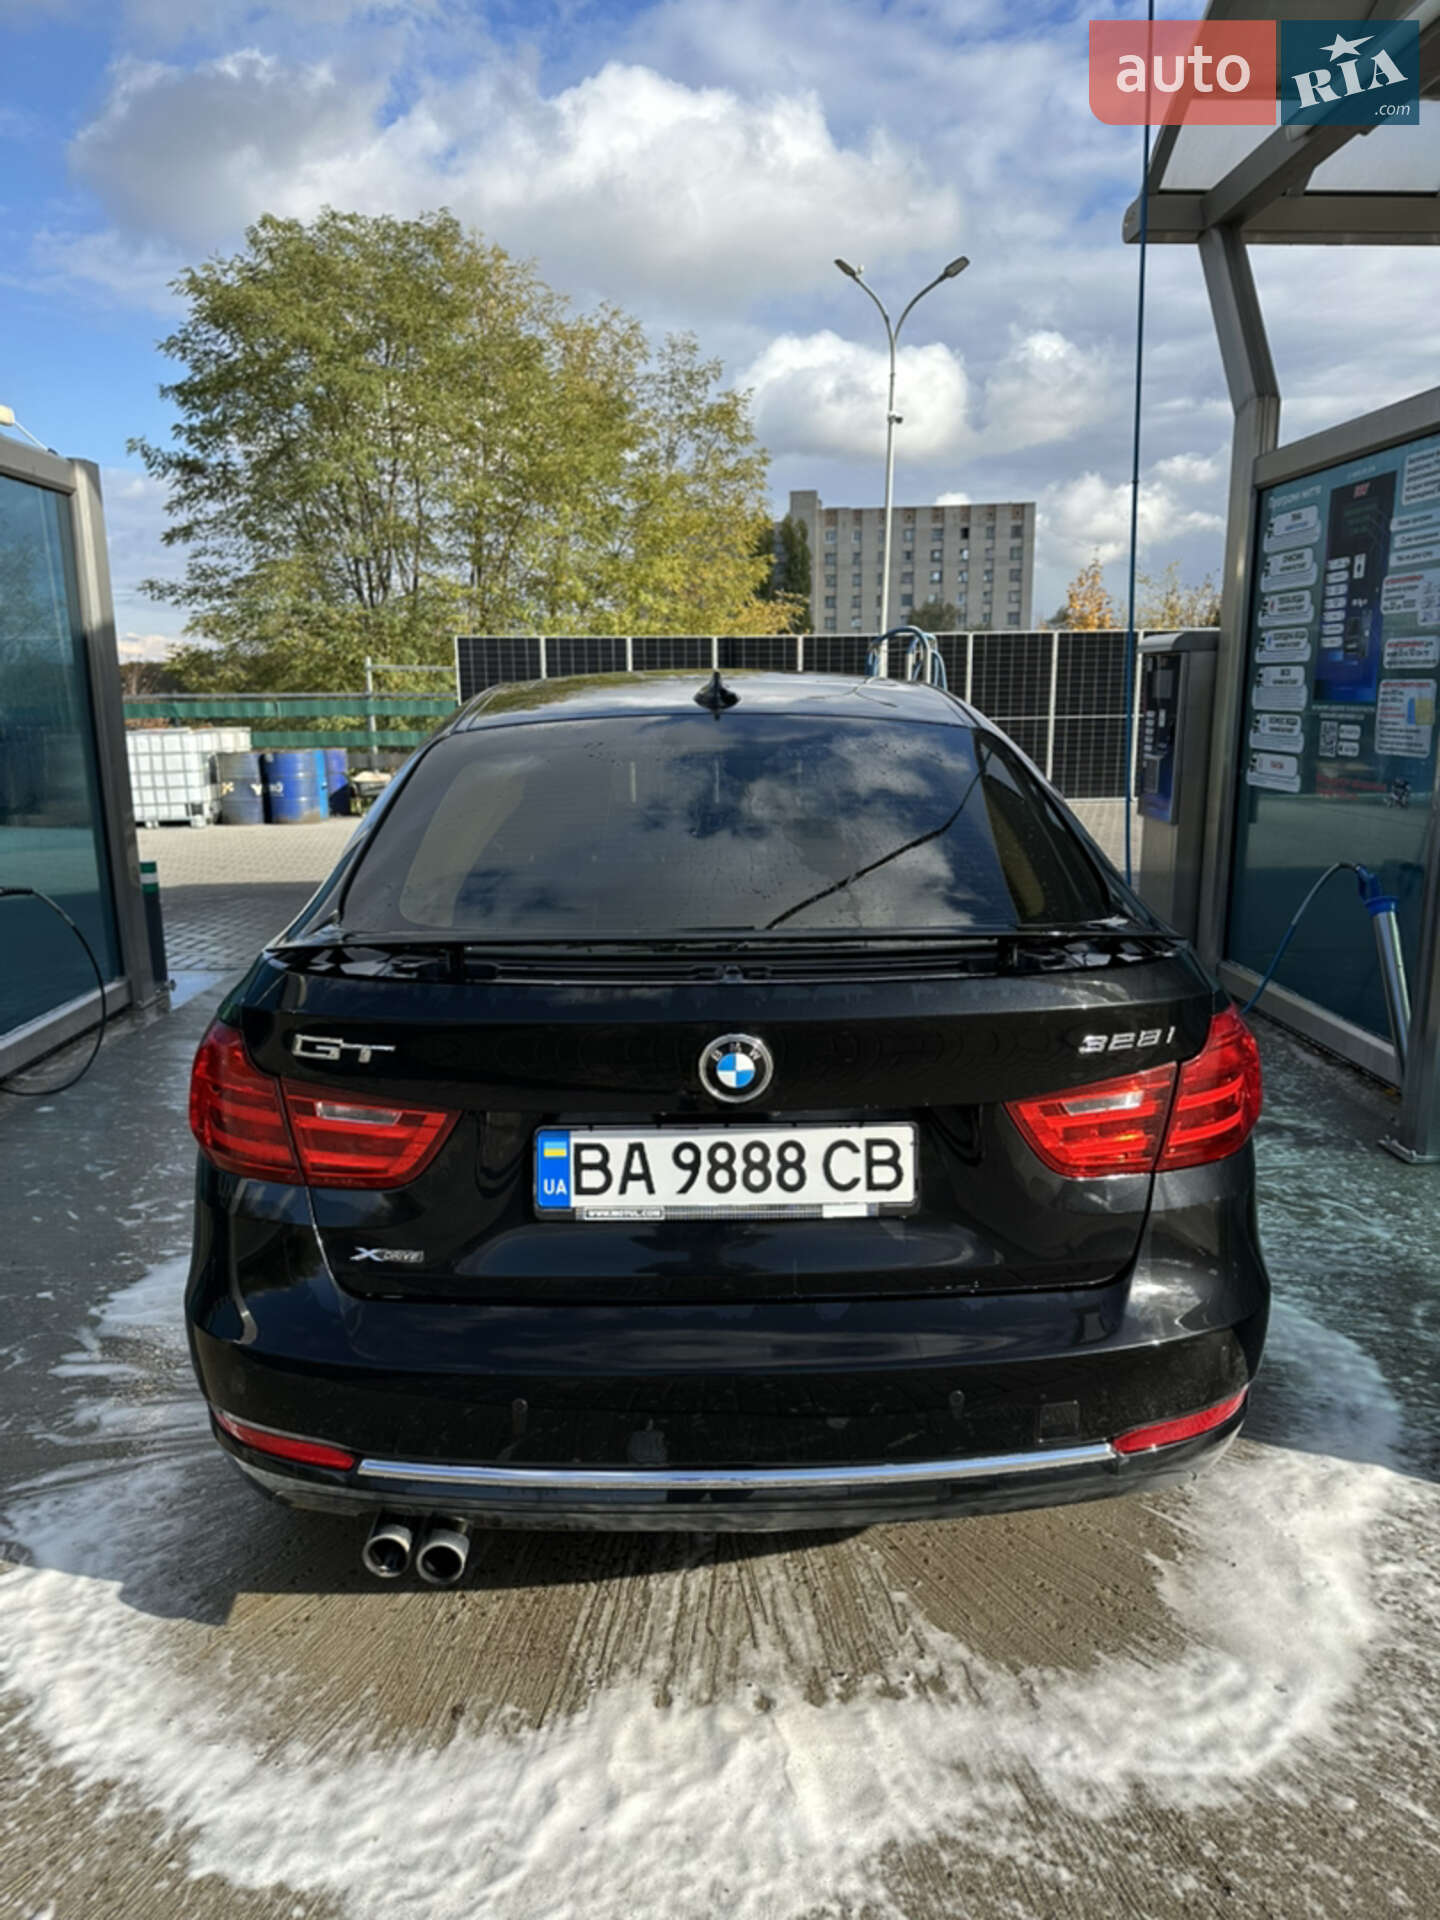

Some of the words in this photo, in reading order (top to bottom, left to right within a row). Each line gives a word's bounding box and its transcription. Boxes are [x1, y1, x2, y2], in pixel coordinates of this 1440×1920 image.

[291, 1033, 397, 1064] GT
[573, 1141, 656, 1196] BA
[672, 1139, 807, 1195] 9888
[822, 1137, 905, 1193] CB
[543, 1178, 568, 1196] UA
